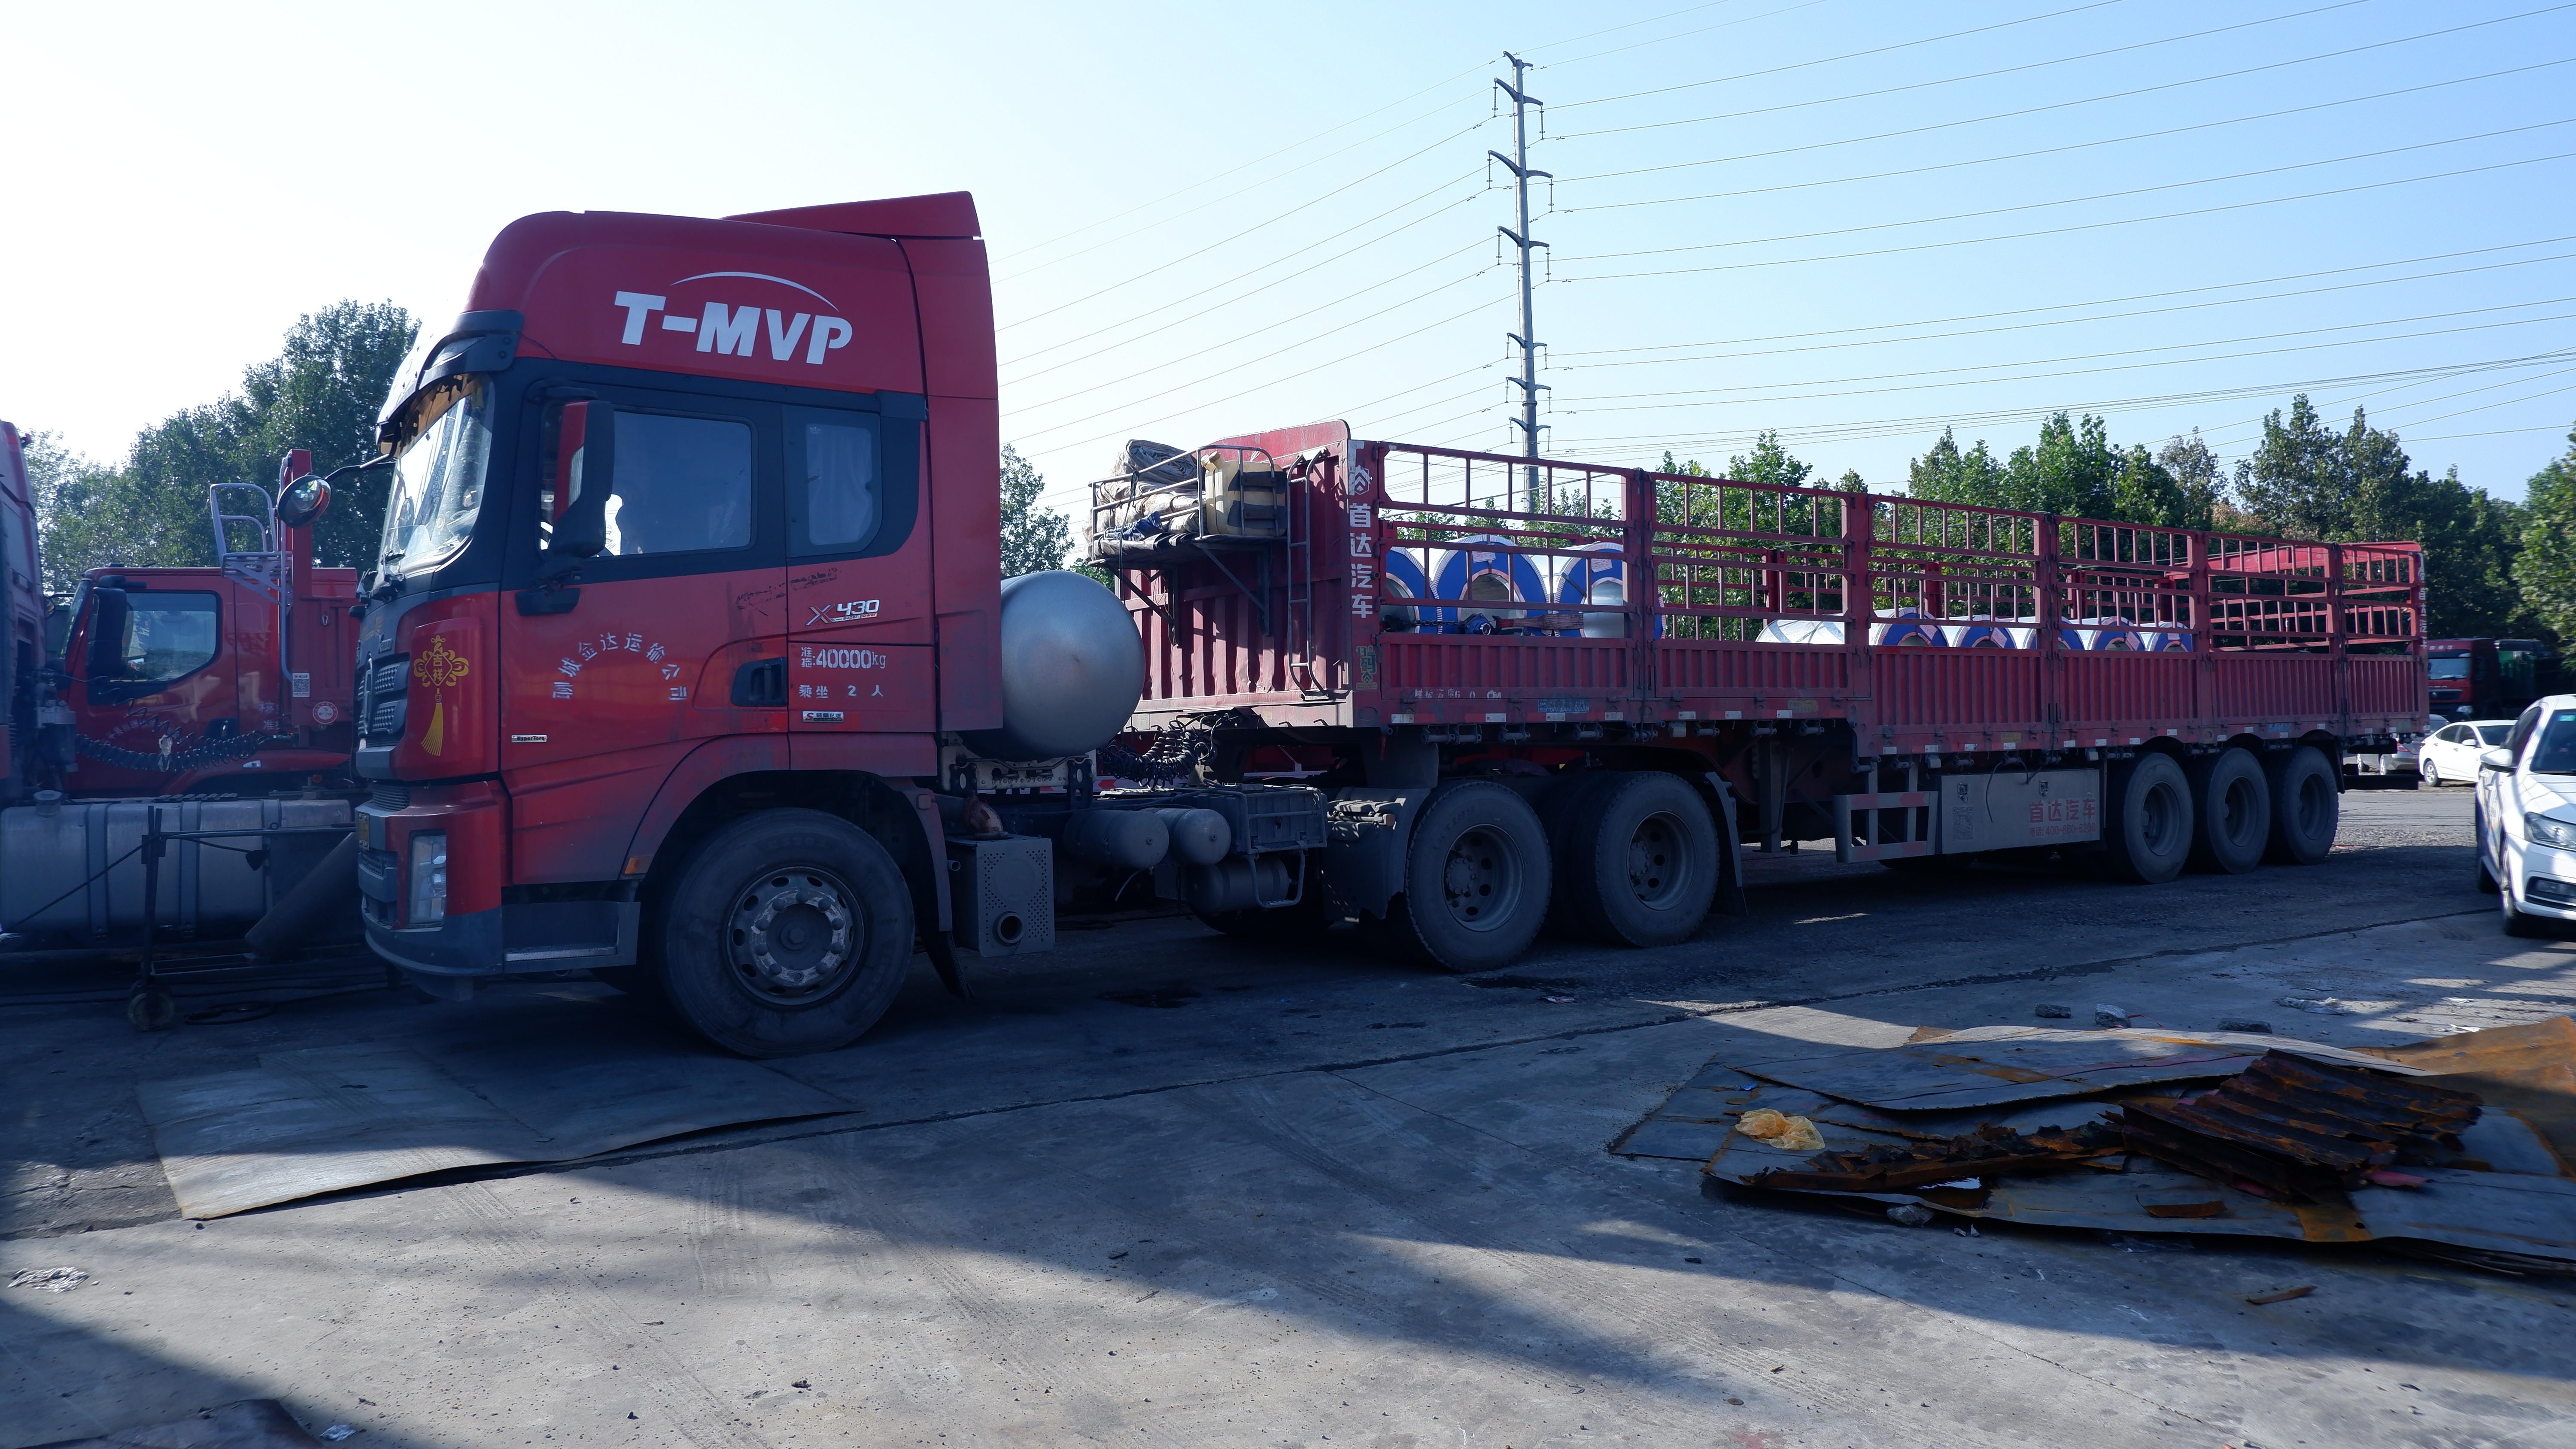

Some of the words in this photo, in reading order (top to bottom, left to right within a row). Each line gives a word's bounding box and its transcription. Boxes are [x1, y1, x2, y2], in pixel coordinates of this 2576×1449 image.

[614, 291, 853, 364] T-MVP
[1349, 503, 1373, 618] 首达汽车
[433, 654, 443, 682] 吉祥
[799, 685, 829, 698] 乘坐
[848, 685, 857, 696] 2
[871, 685, 884, 697] 人
[2030, 798, 2096, 823] 首达汽车
[2046, 822, 2095, 836] 400-800-6200
